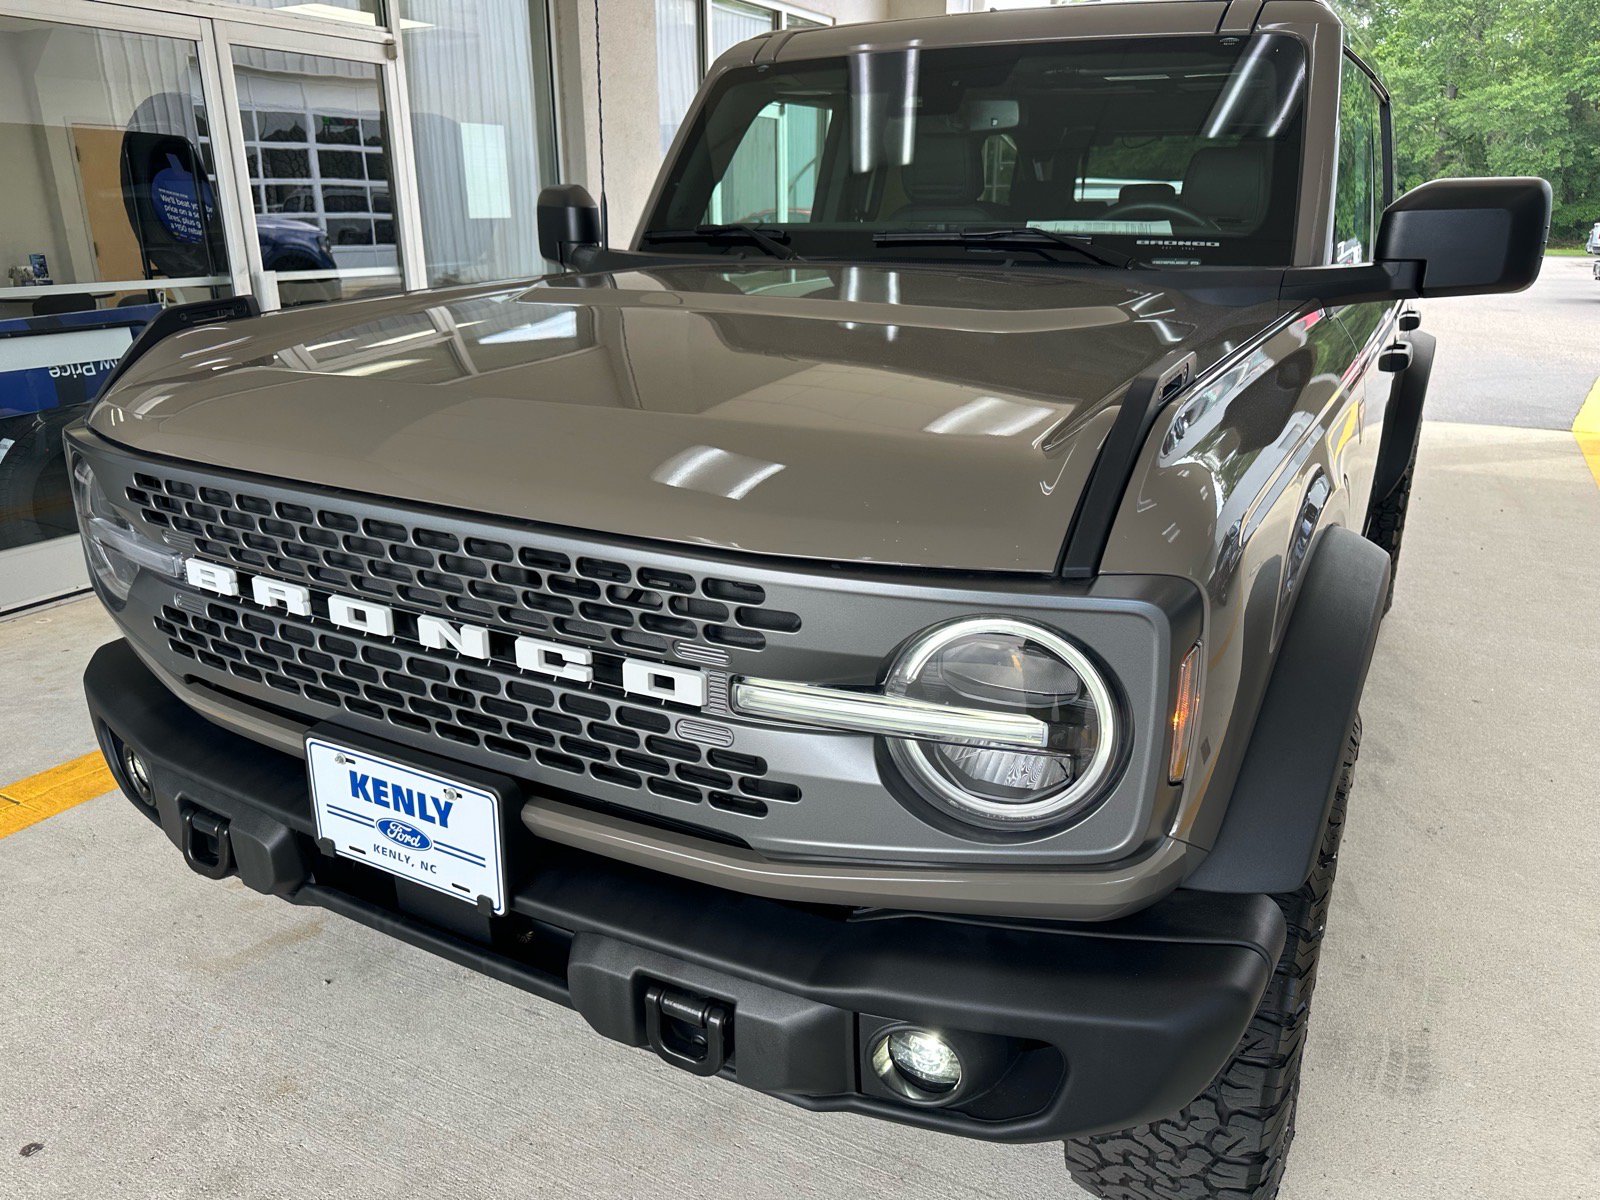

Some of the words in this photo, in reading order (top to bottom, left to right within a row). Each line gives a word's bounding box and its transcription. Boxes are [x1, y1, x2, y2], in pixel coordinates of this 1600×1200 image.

[164, 205, 178, 214] price
[176, 197, 190, 208] beat
[48, 362, 97, 378] Price
[185, 558, 708, 707] BRONCO
[349, 770, 453, 828] KENLY
[385, 819, 422, 848] Ford
[373, 843, 415, 868] KENLY,
[420, 860, 437, 874] NC
